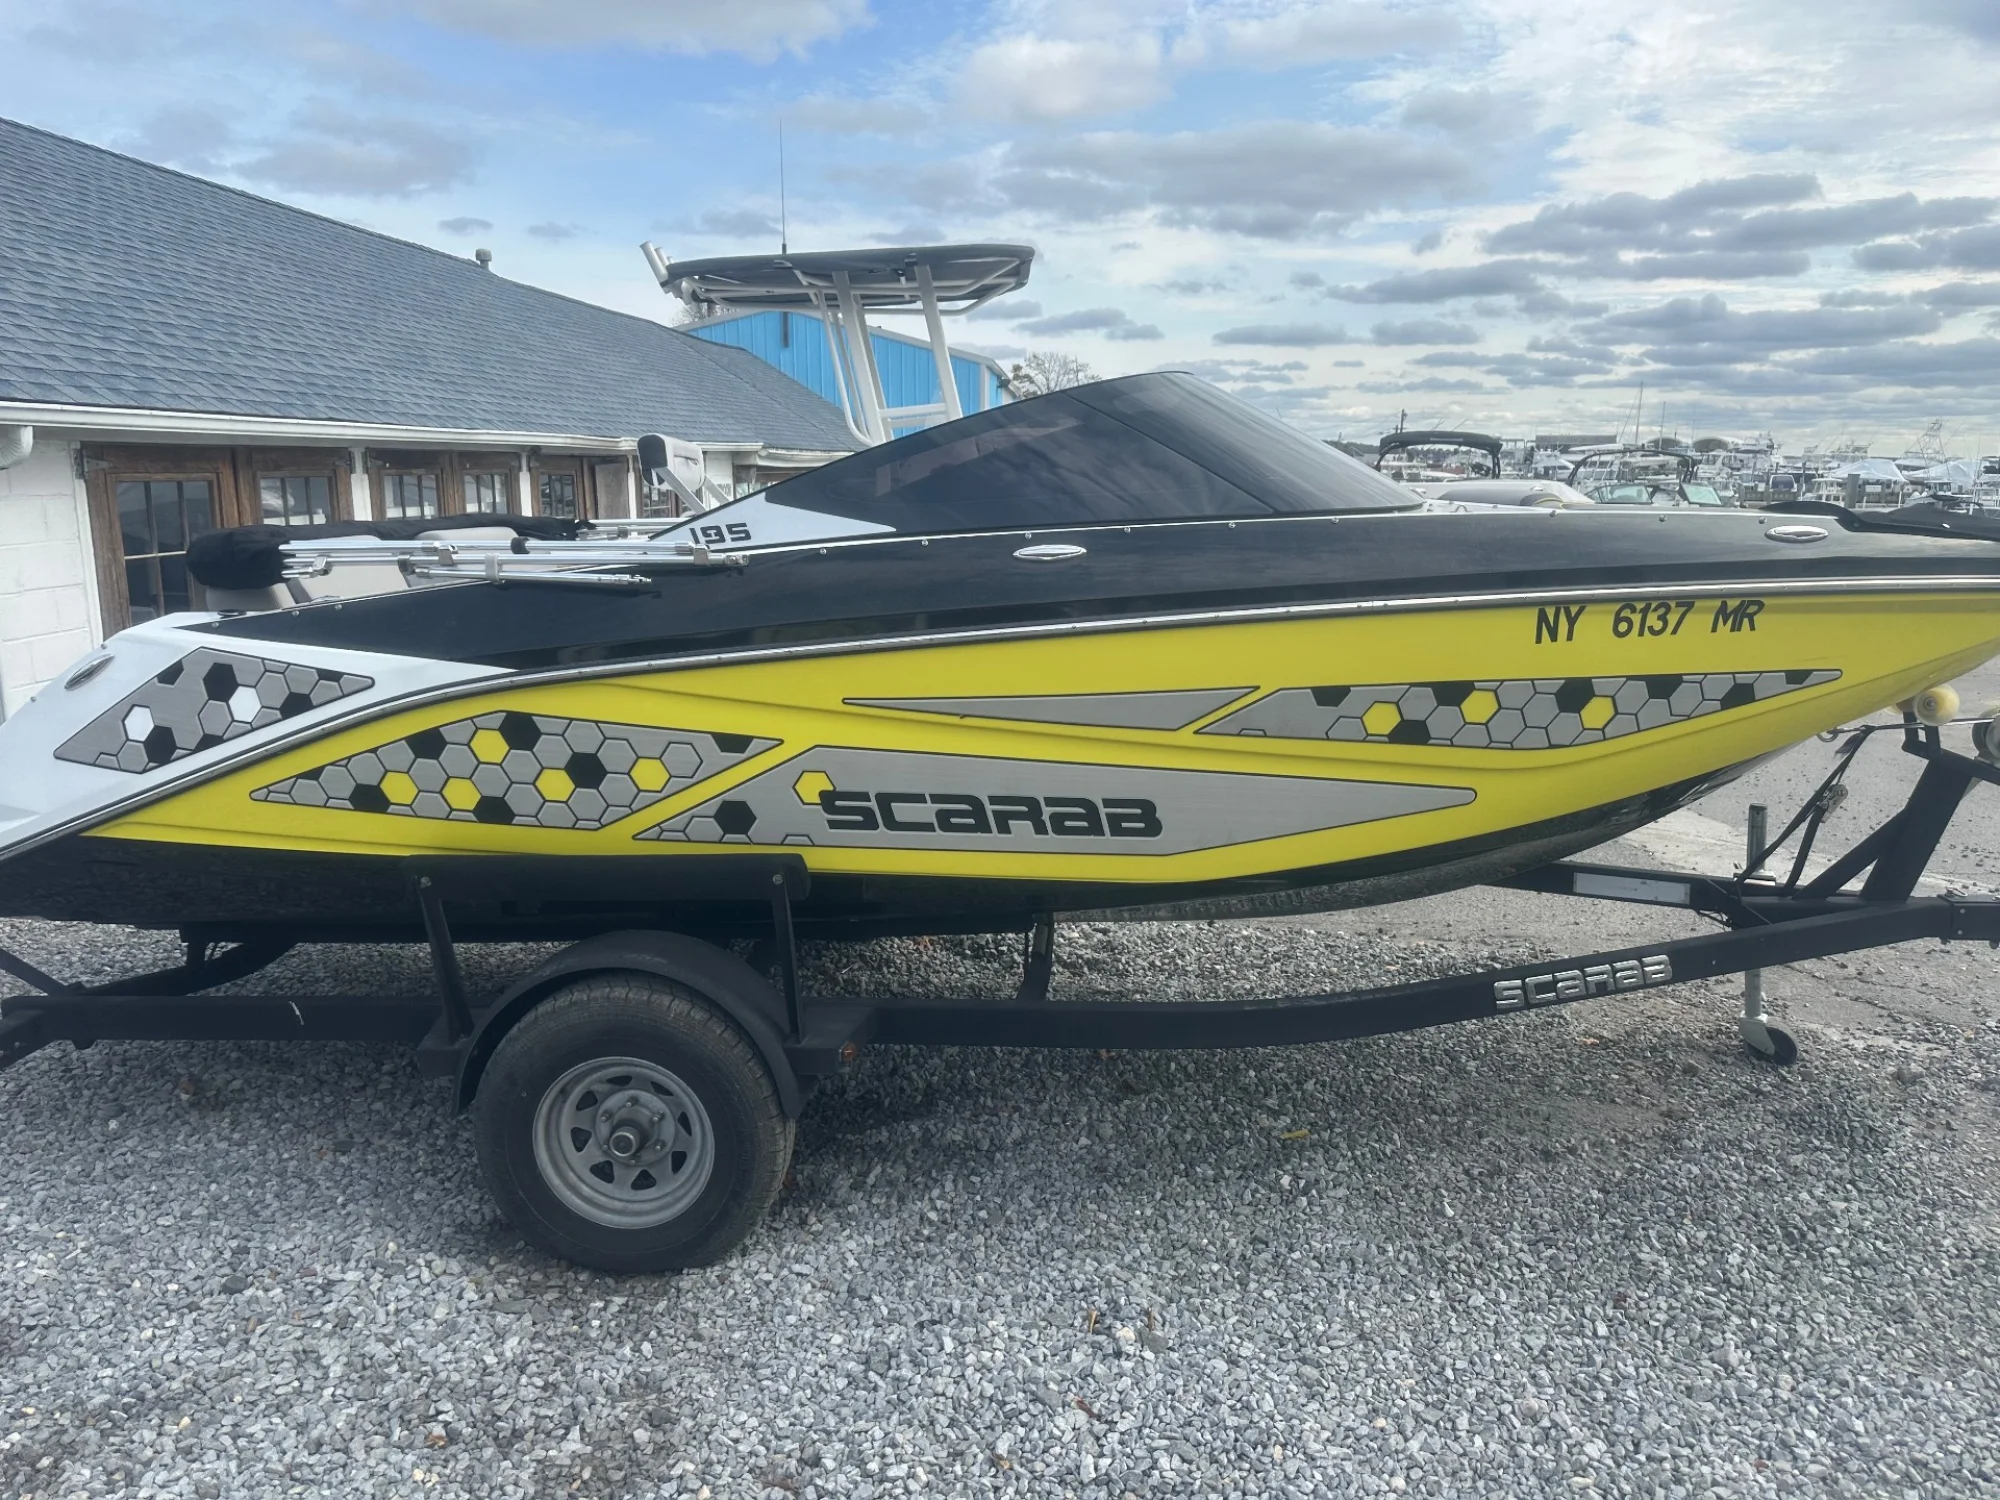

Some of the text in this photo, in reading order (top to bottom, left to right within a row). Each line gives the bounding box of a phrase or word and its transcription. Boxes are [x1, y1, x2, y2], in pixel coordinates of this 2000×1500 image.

[689, 522, 752, 544] 195
[1535, 599, 1766, 645] NY 6137 MR
